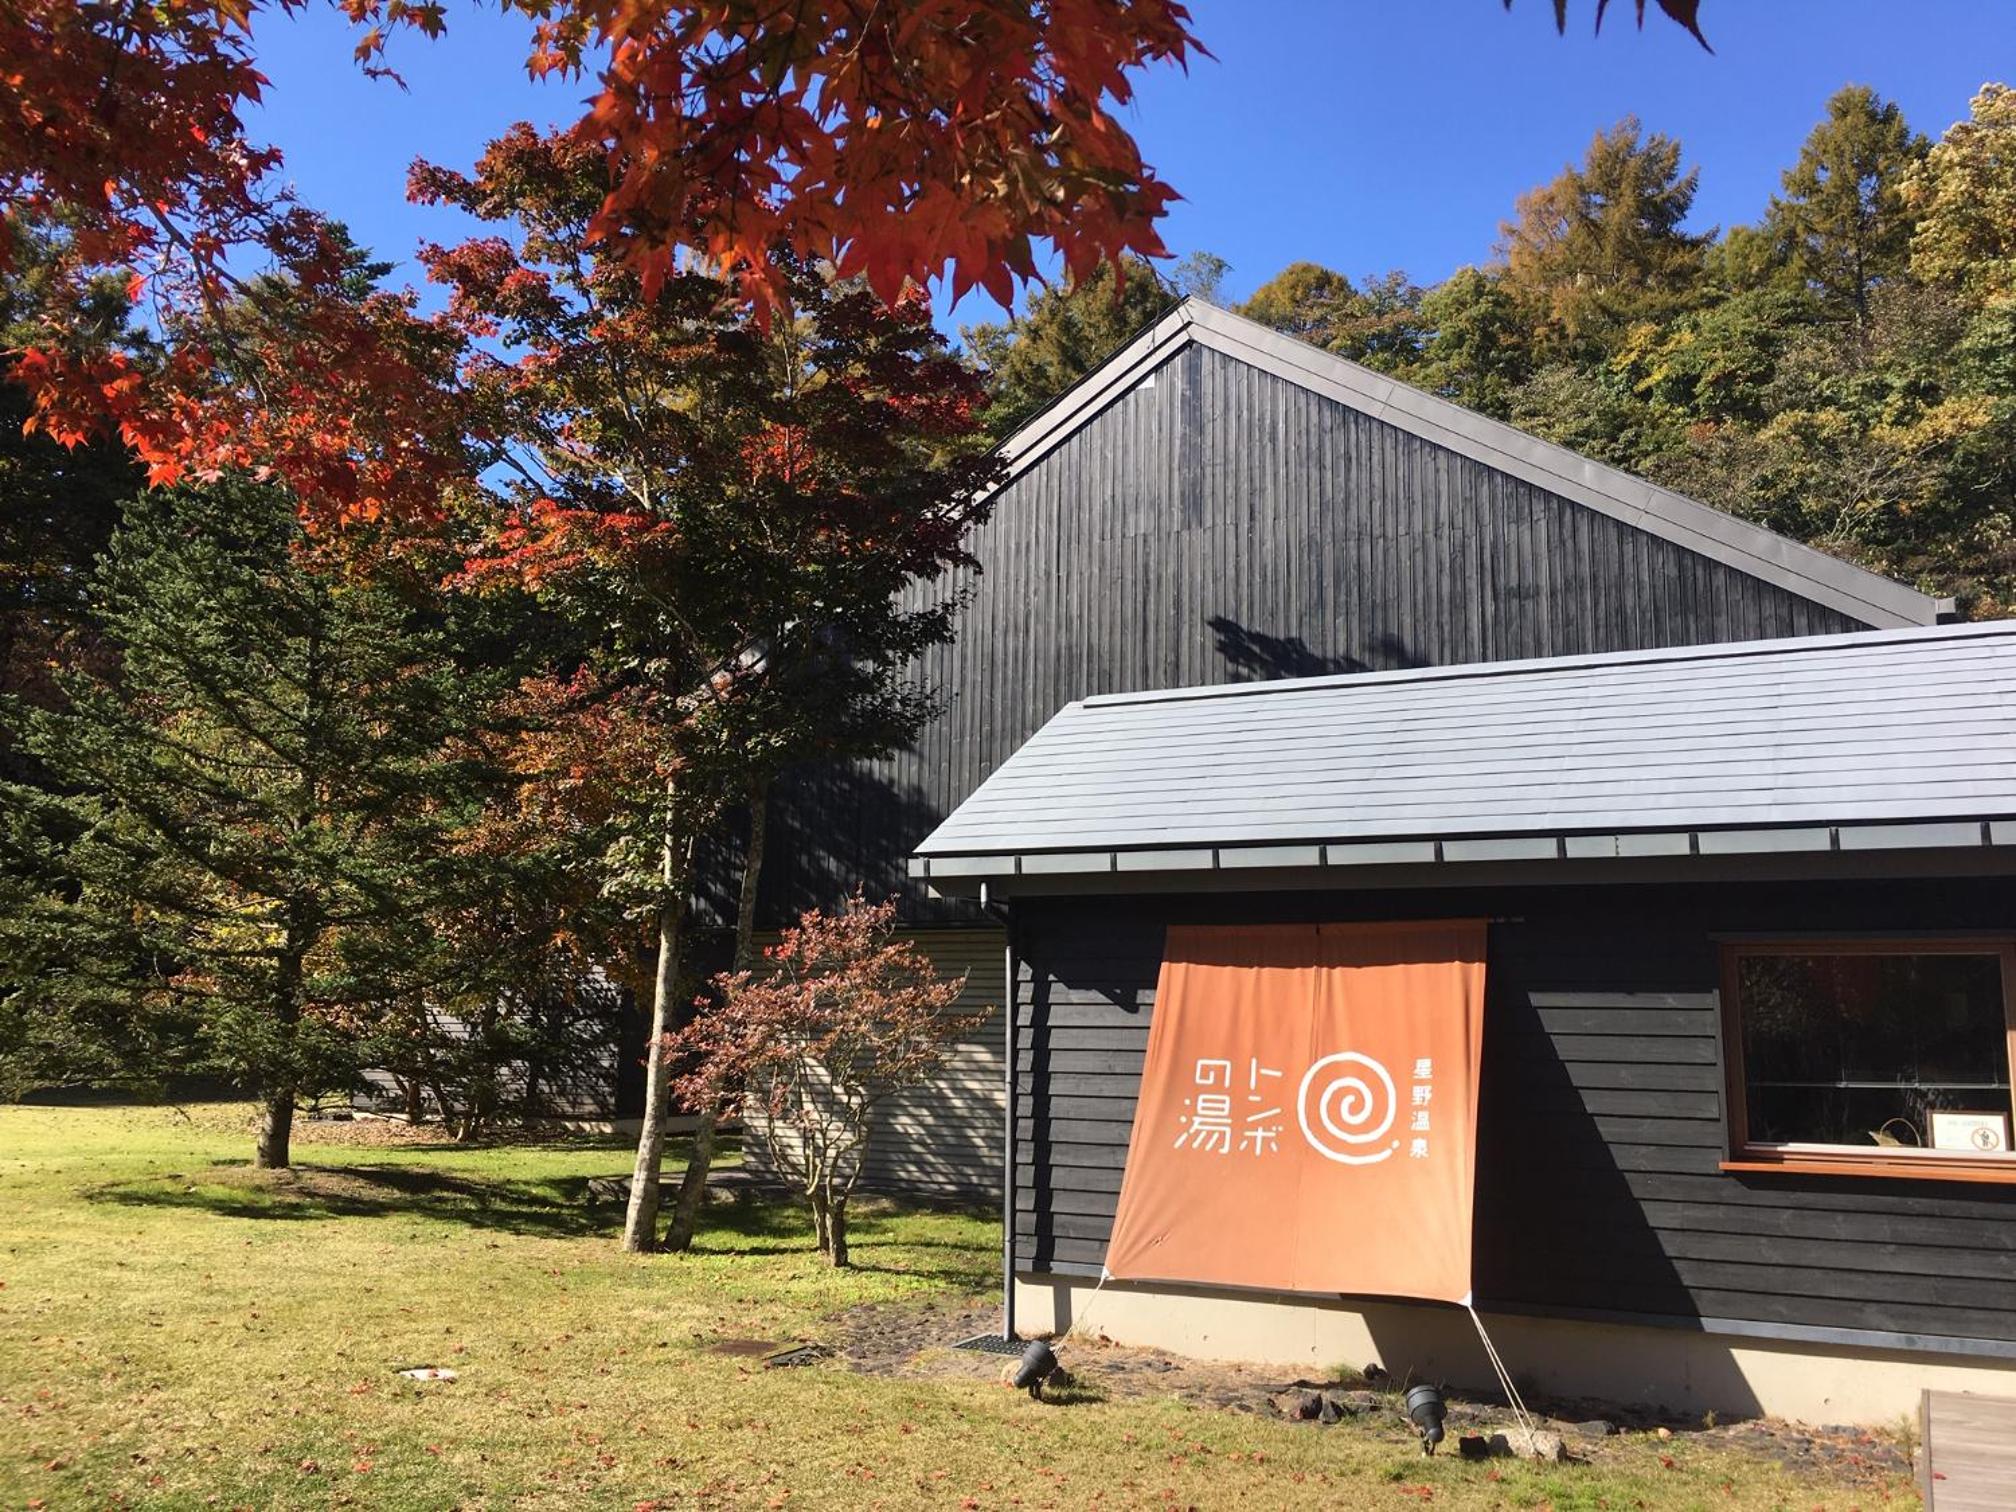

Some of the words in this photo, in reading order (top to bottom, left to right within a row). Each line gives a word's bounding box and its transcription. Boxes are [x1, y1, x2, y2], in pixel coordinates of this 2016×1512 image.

[1173, 1058, 1233, 1154] の湯
[1238, 1056, 1284, 1157] トンボ
[1409, 1058, 1433, 1159] 星野温泉
